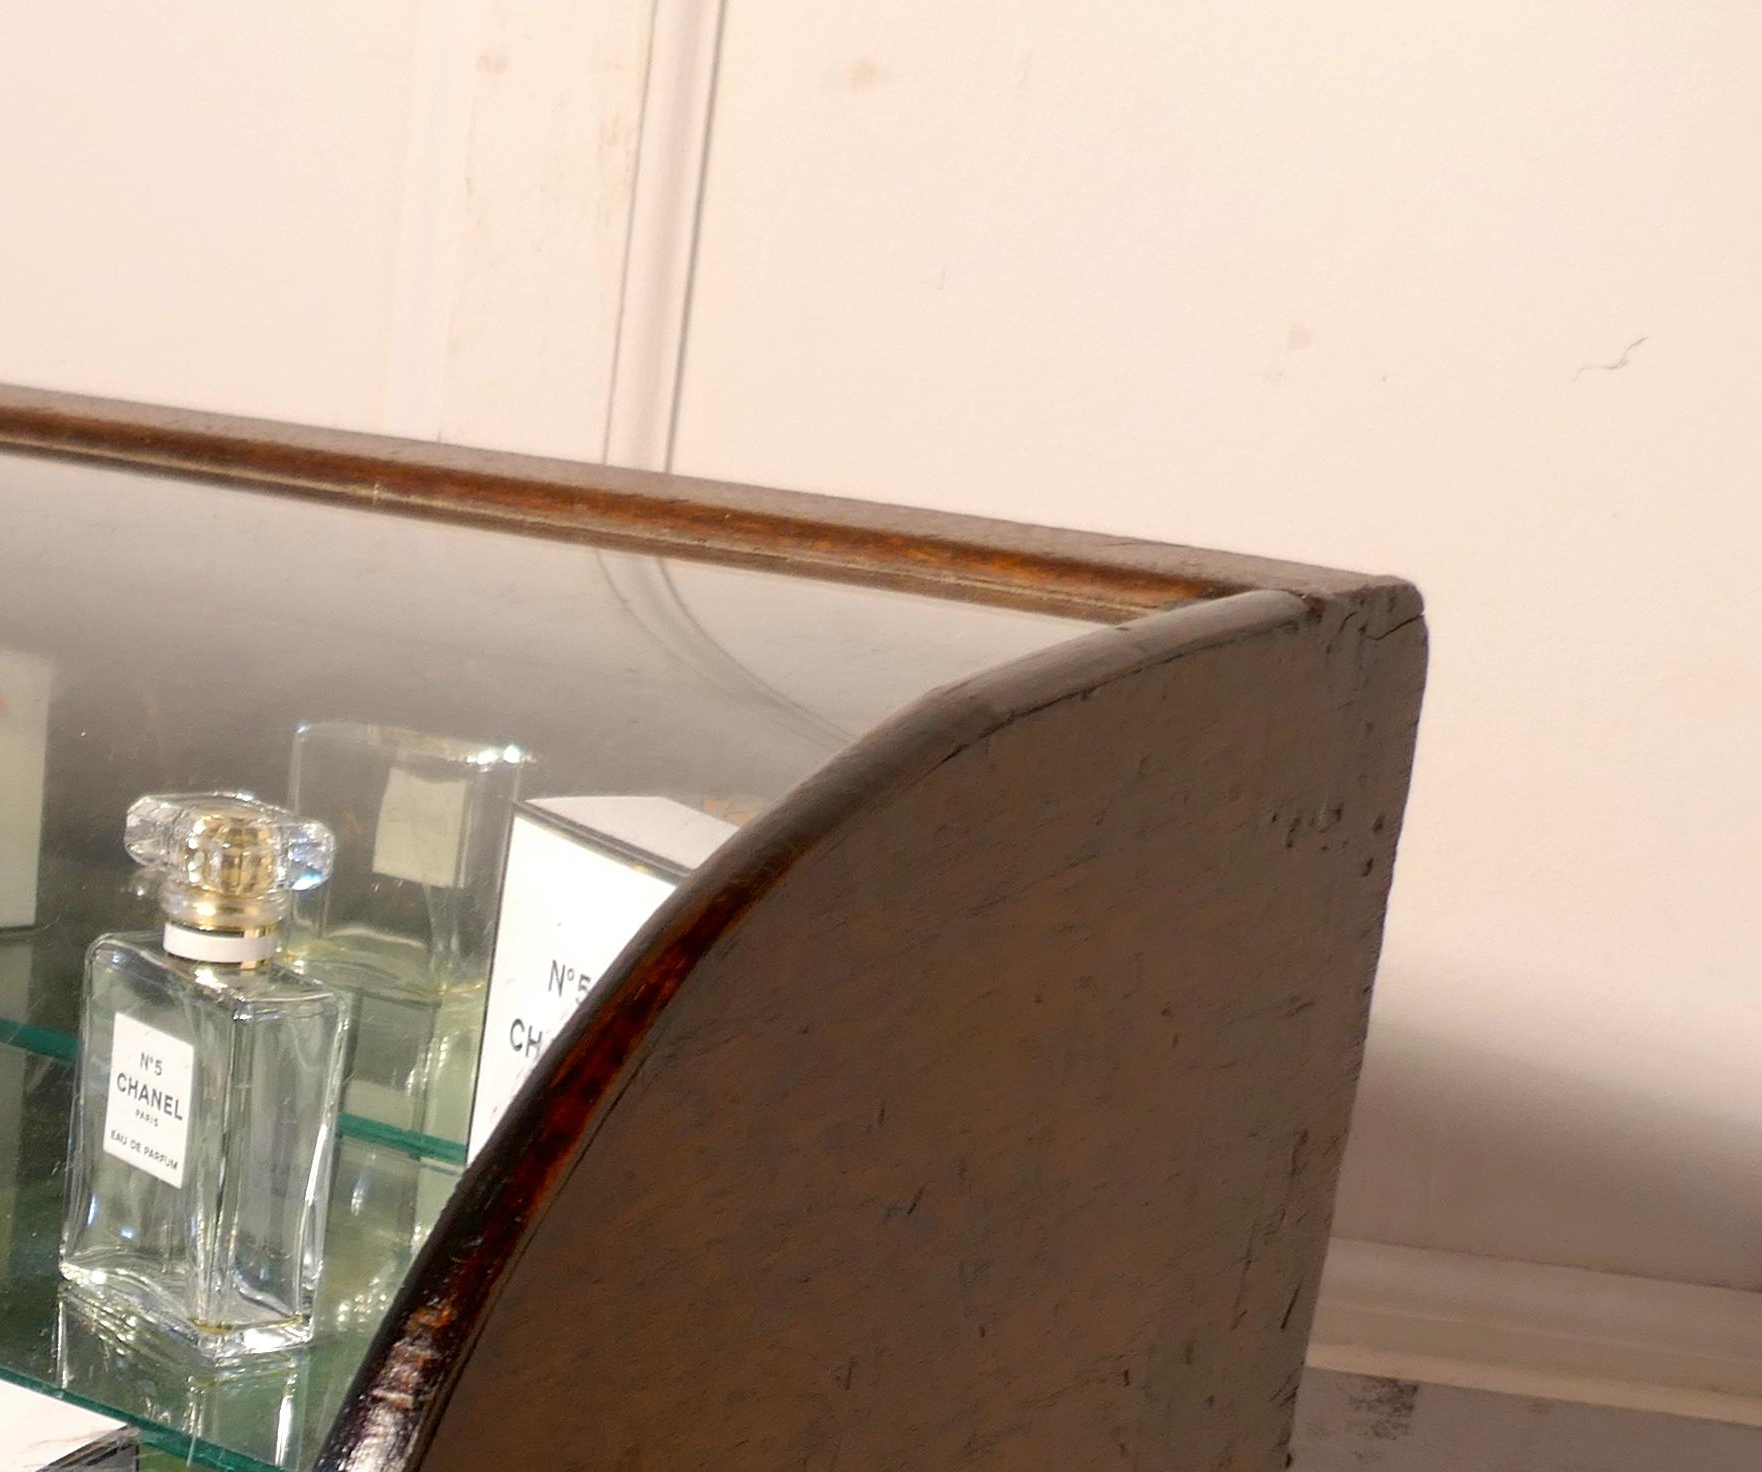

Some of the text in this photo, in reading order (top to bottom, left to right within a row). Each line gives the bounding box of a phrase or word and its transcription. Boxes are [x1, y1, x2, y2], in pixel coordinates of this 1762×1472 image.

[116, 1073, 183, 1121] CHANEL
[135, 1109, 159, 1128] PARIS
[110, 1129, 179, 1171] EAU DE PARFUM
